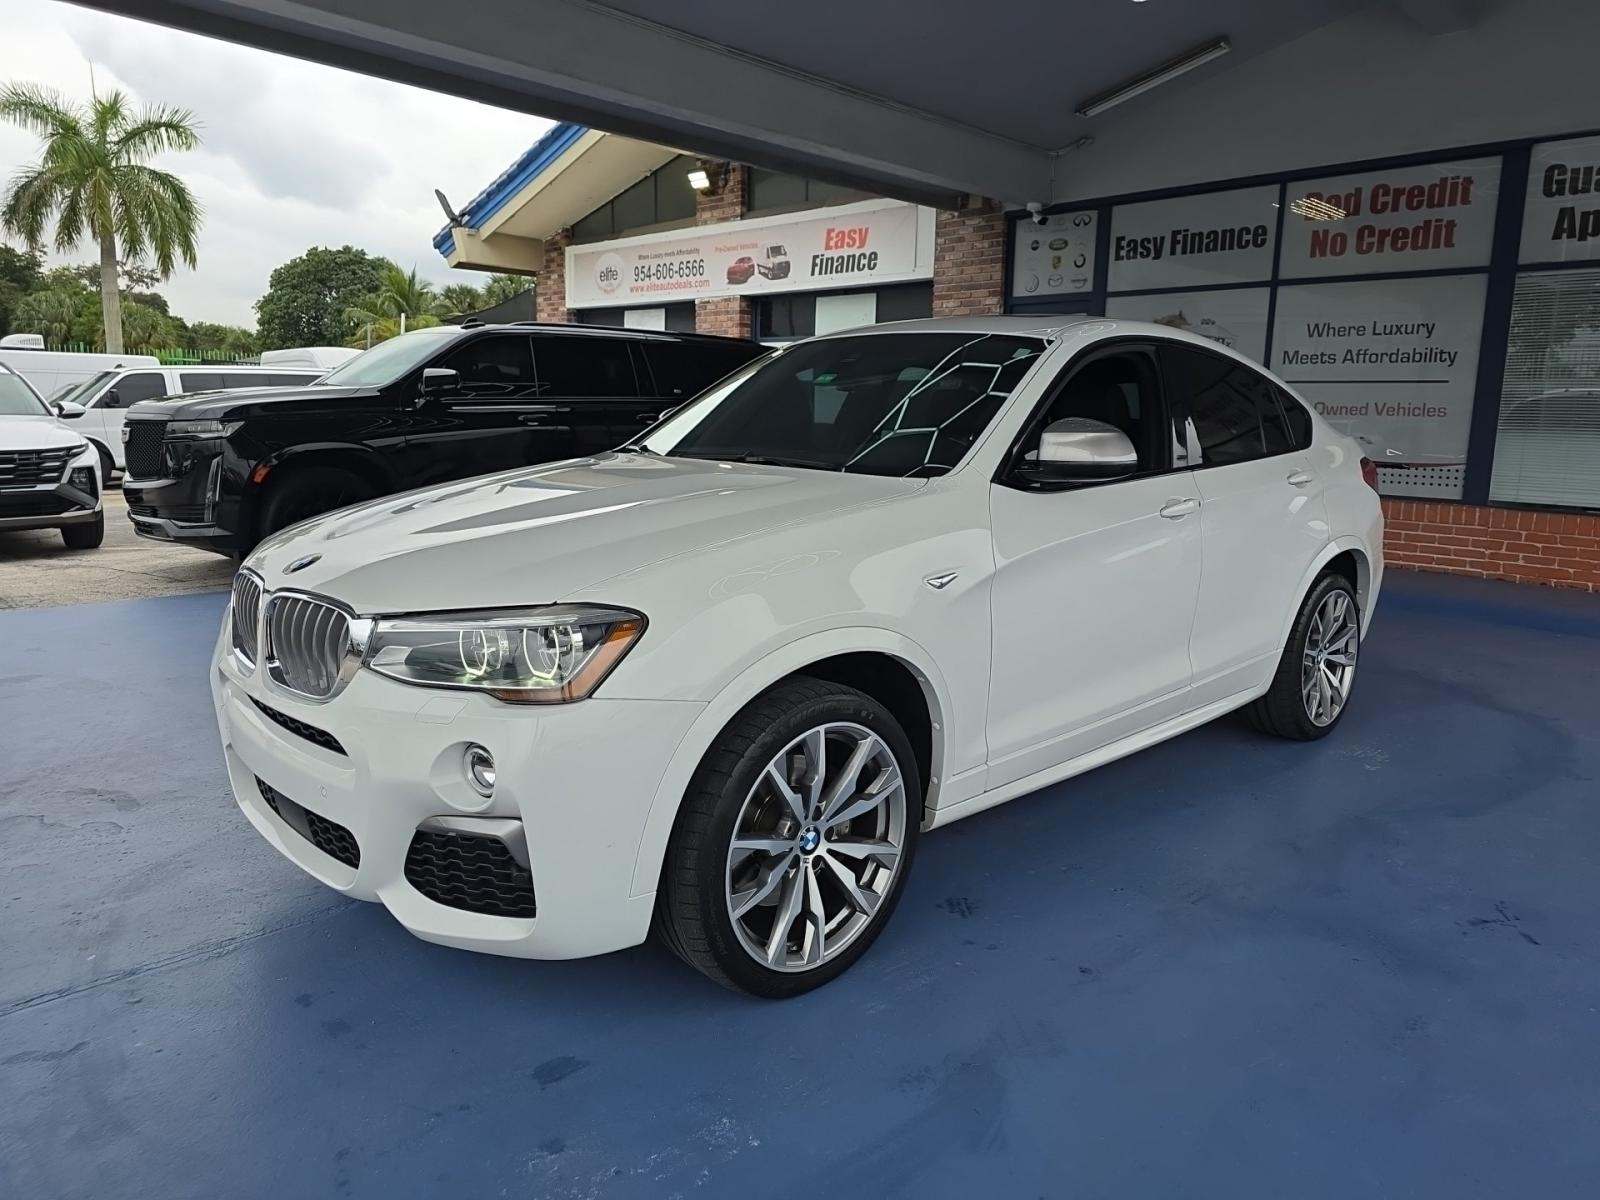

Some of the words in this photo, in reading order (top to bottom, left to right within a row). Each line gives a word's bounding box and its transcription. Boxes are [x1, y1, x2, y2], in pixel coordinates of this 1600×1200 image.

[1543, 163, 1600, 198] Gu
[1369, 175, 1474, 215] Credit
[824, 227, 870, 251] Easy
[1114, 235, 1166, 261] Easy
[1169, 224, 1268, 257] Finance
[1310, 229, 1347, 259] No
[1355, 218, 1458, 255] Credit
[600, 267, 618, 282] elite
[634, 259, 705, 282] 954-606-6566
[811, 251, 879, 277] Finance
[1307, 322, 1366, 338] Where
[1372, 321, 1436, 339] Luxury
[1282, 349, 1337, 365] Meets
[1342, 347, 1458, 367] Affordability
[1374, 402, 1448, 418] Vehicles
